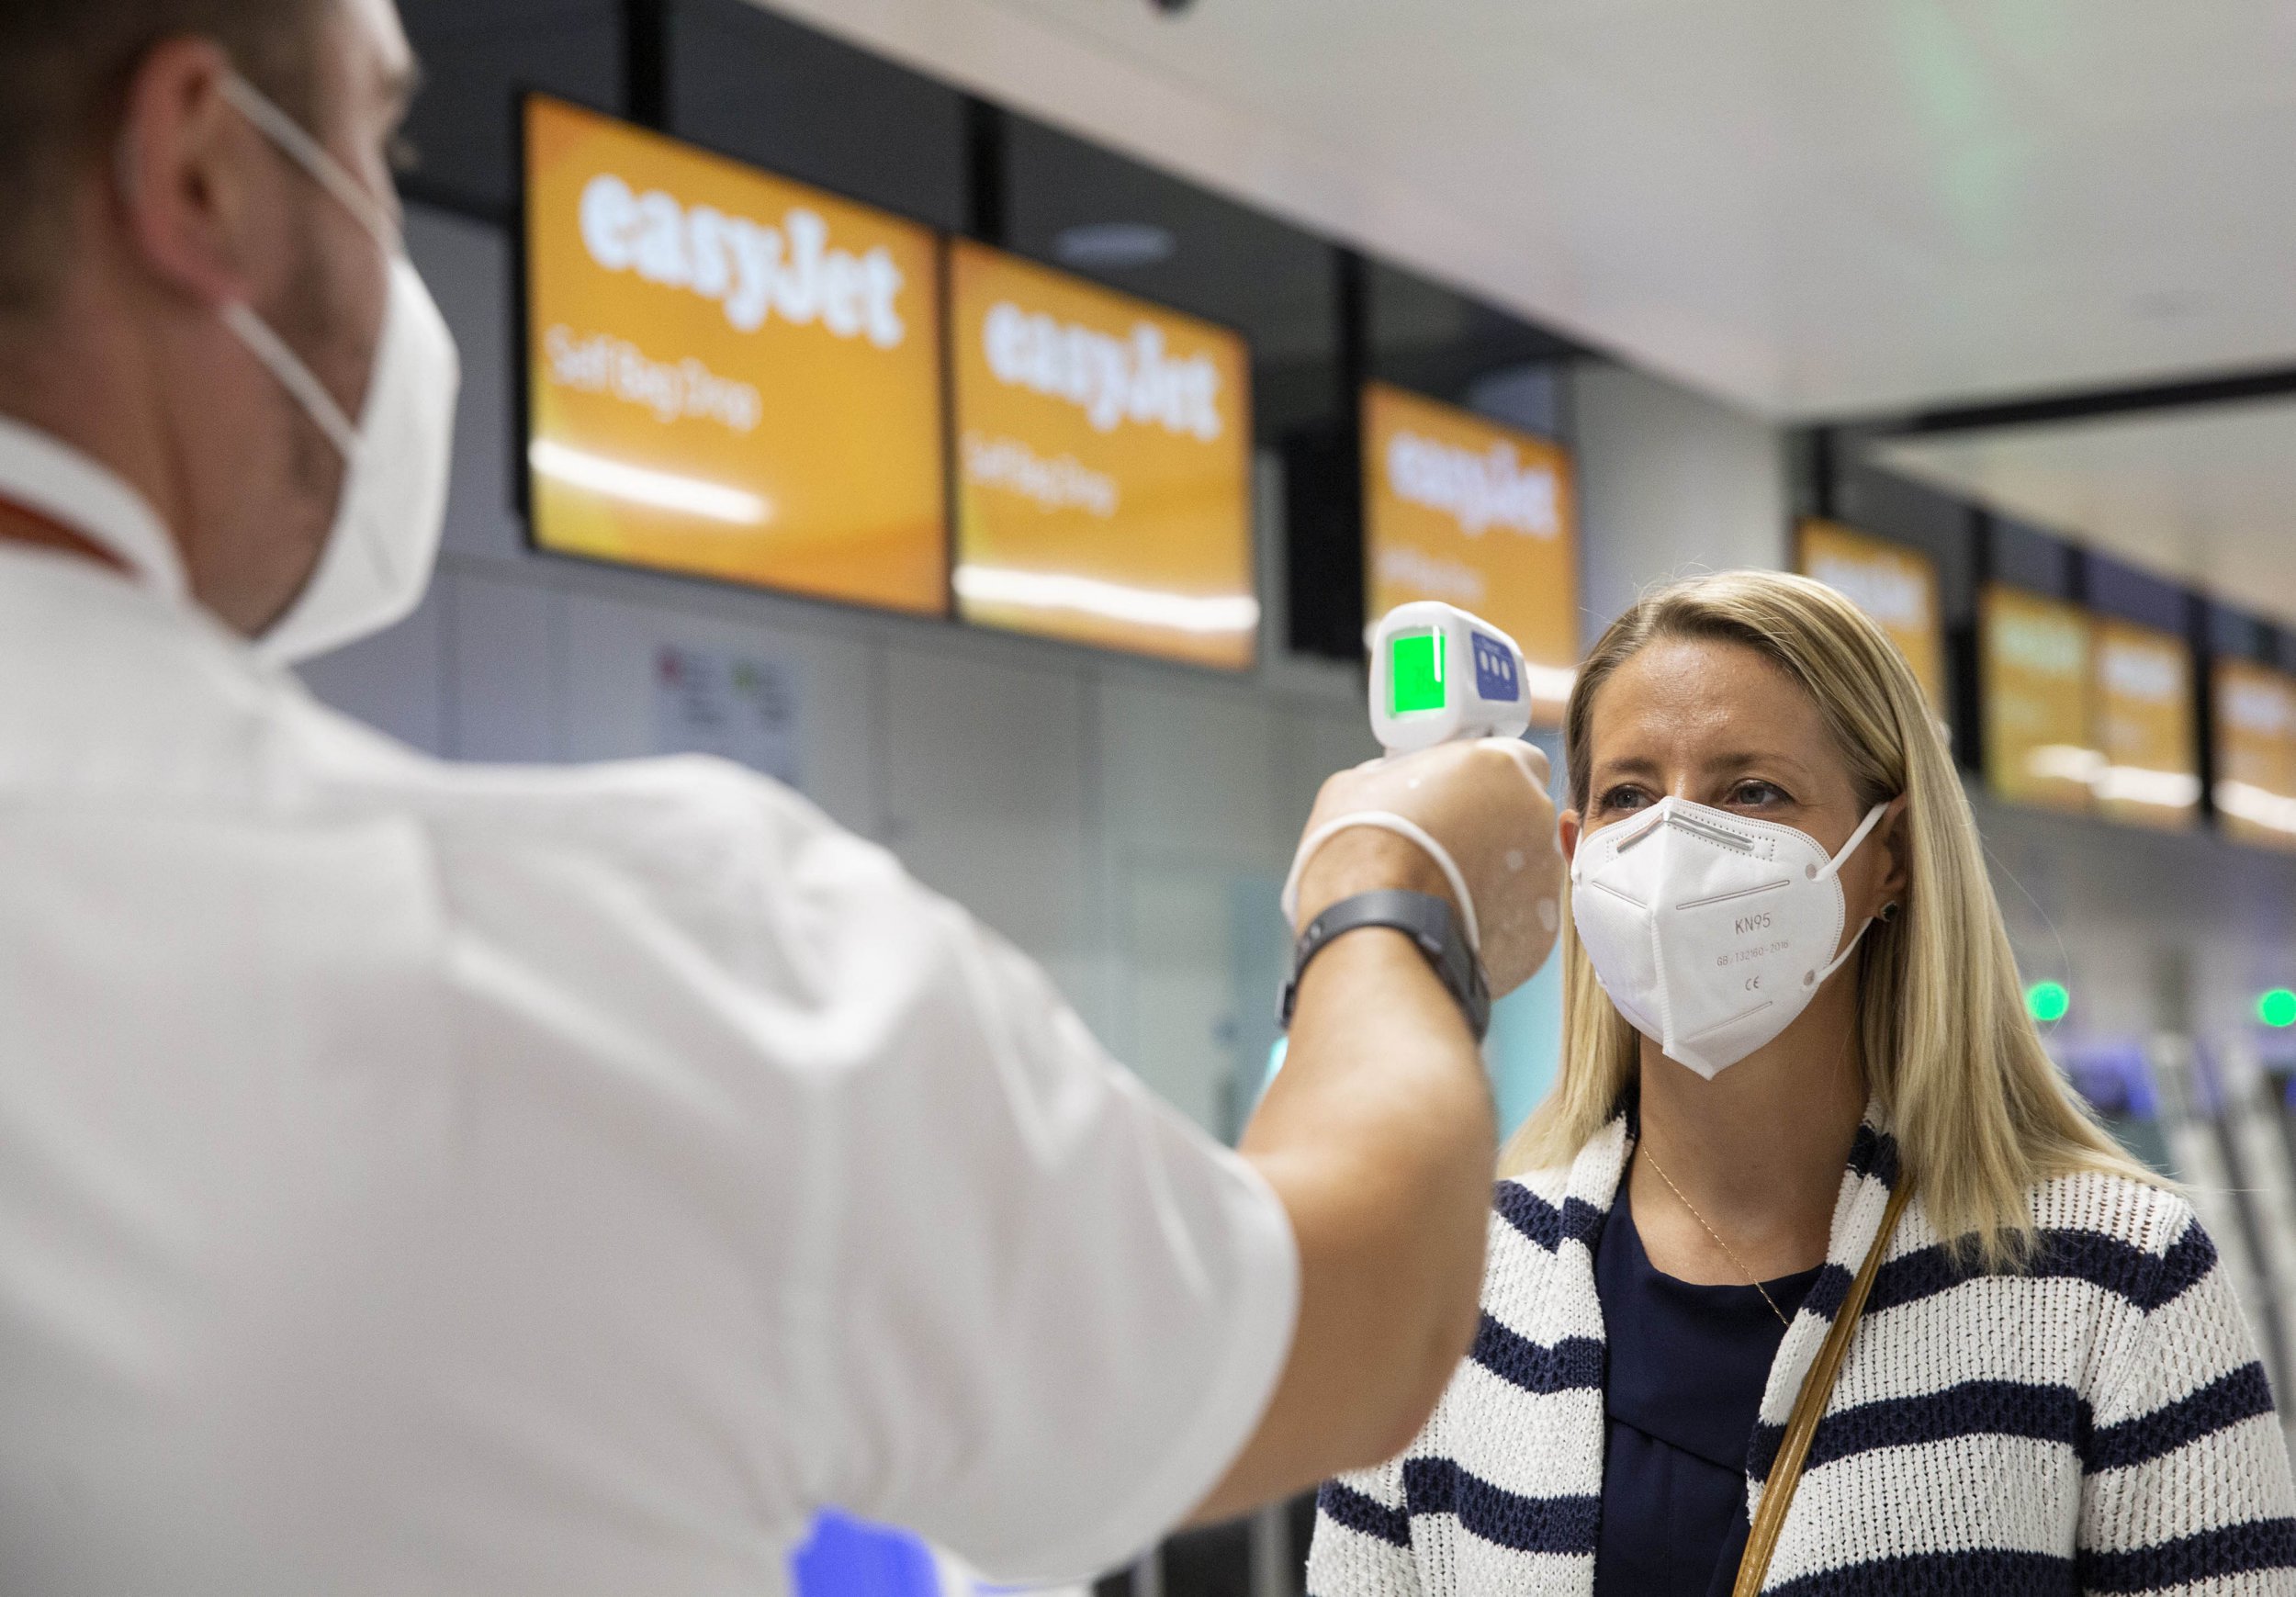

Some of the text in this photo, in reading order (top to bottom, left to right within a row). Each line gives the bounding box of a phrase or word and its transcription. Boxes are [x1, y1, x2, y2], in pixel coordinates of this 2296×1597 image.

[580, 174, 904, 348] easyJet
[985, 302, 1221, 441] easyJet
[1734, 912, 1772, 935] KN95
